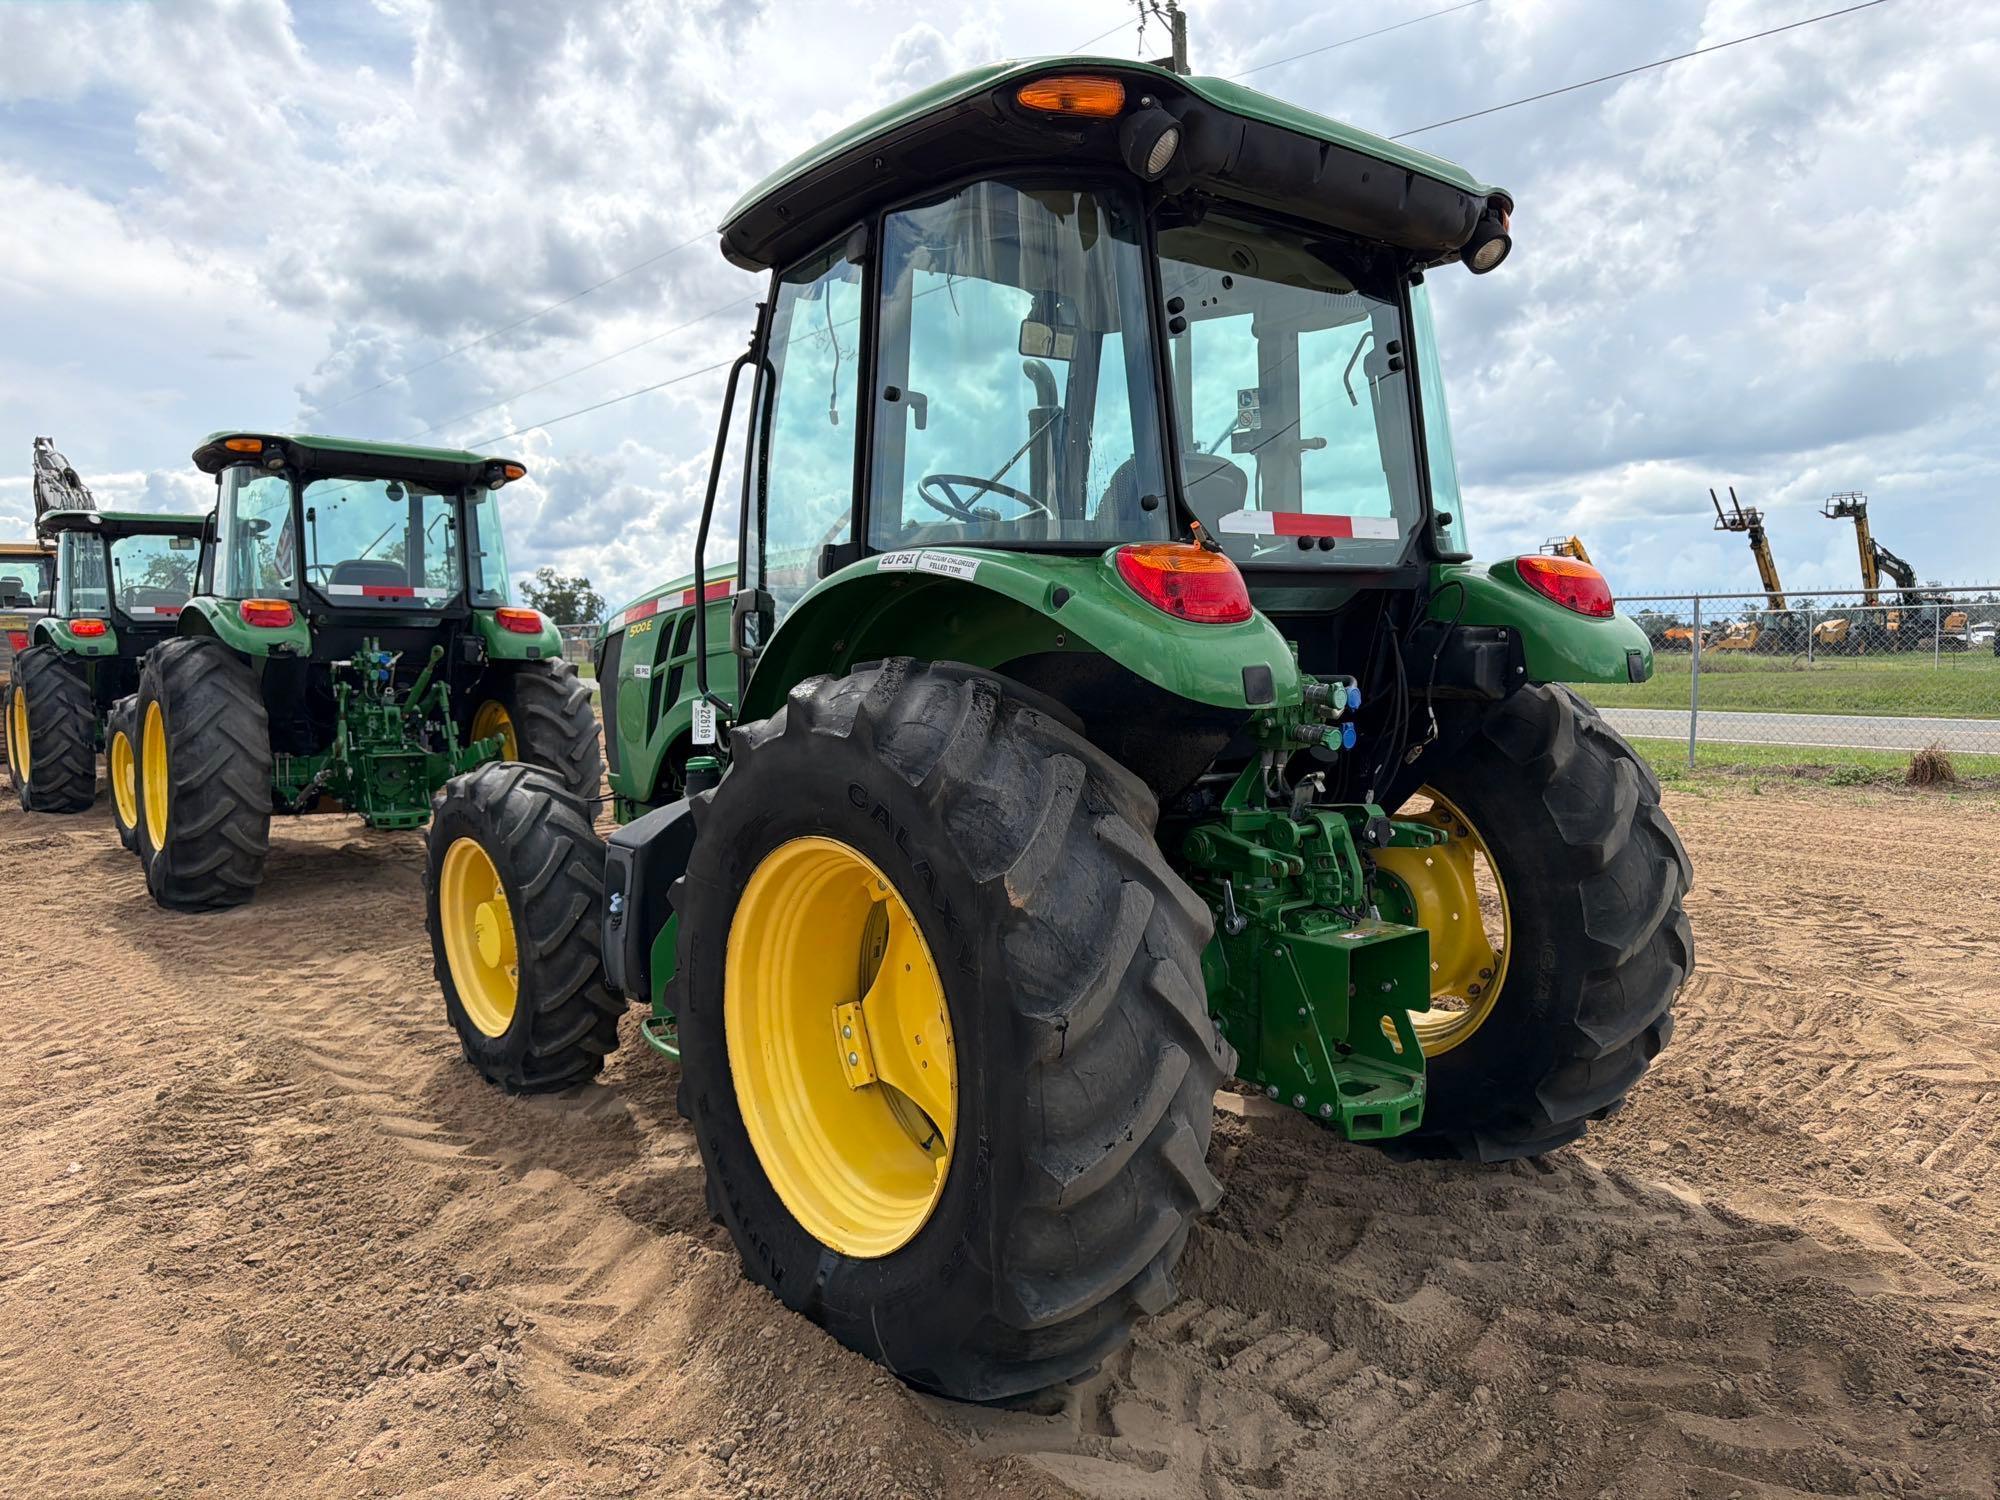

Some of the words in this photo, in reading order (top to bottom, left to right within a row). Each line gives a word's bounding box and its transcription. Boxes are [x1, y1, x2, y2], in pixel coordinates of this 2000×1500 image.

[881, 554, 896, 564] 20
[896, 553, 916, 564] PSI
[923, 553, 948, 562] CALCIUM
[947, 556, 977, 568] CHLORIDE
[929, 562, 948, 572] FILLED
[948, 566, 962, 575] TIRE
[700, 709, 711, 739] 226169
